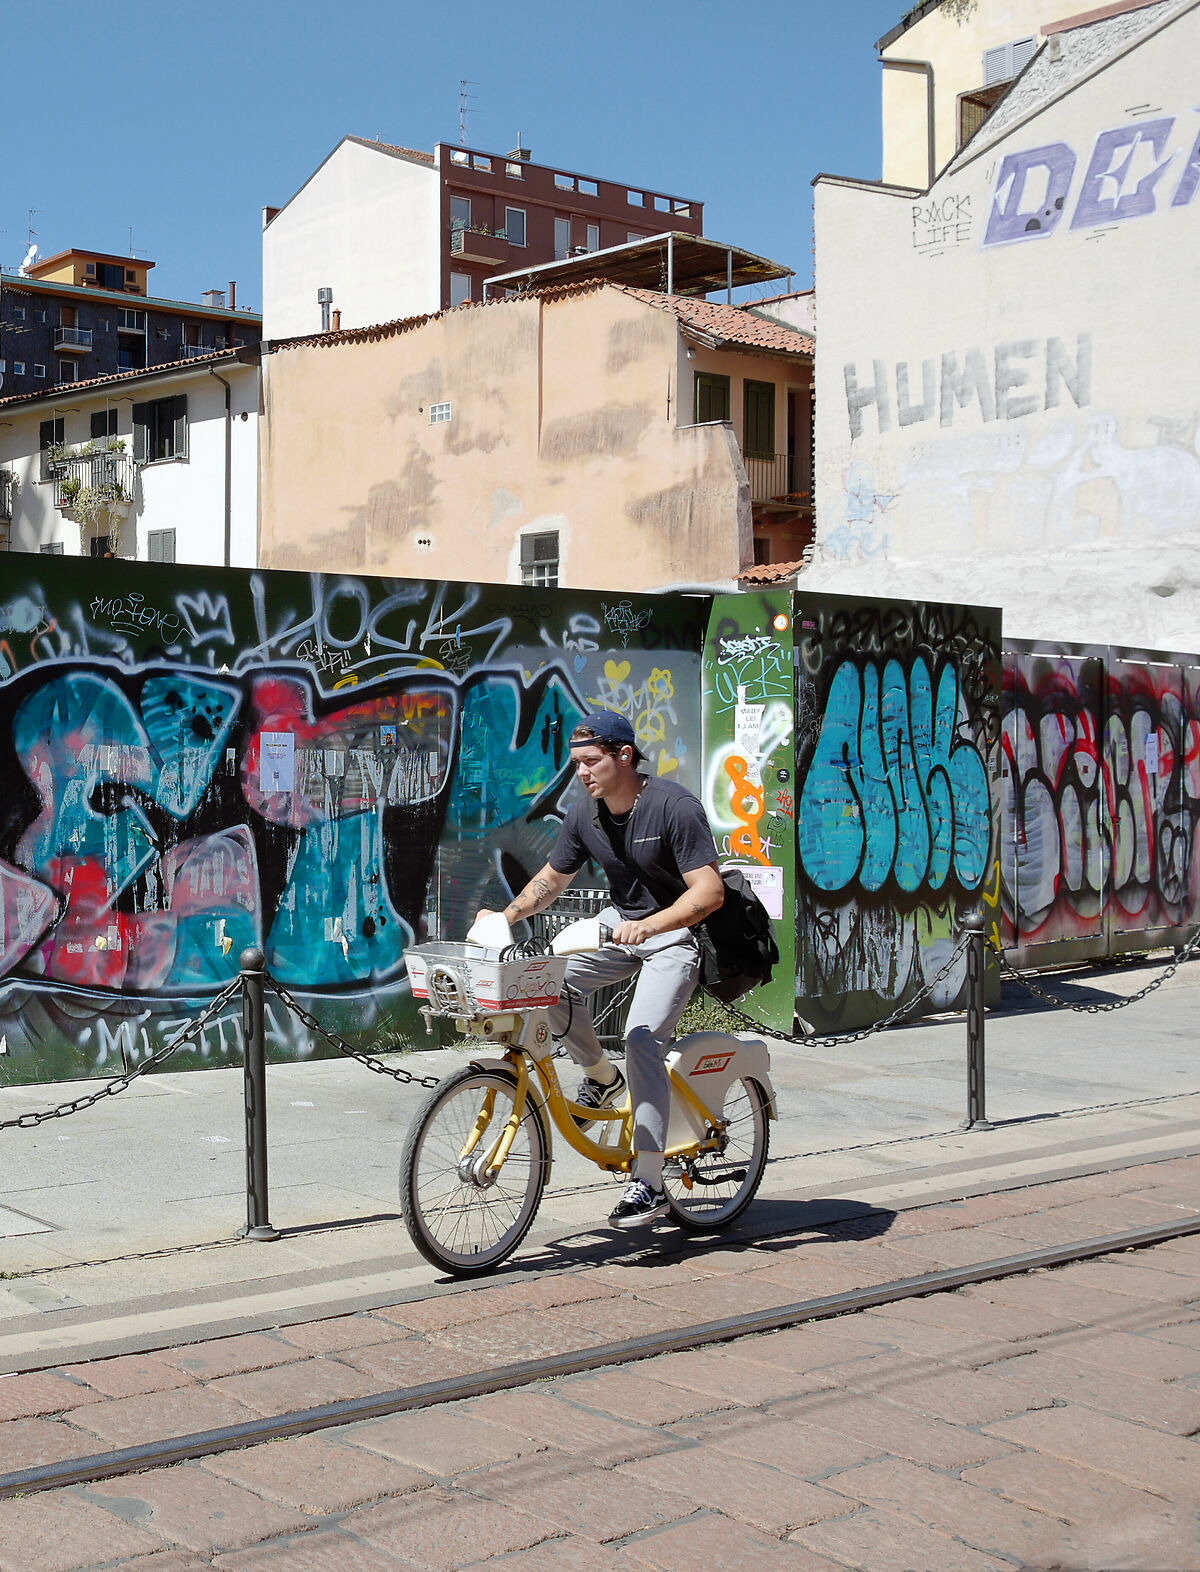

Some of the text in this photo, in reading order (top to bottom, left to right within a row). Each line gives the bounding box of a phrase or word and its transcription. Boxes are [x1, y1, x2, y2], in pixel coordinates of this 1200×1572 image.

[911, 194, 973, 228] RACK
[912, 221, 972, 248] LIFE
[842, 331, 1092, 444] HUMEN
